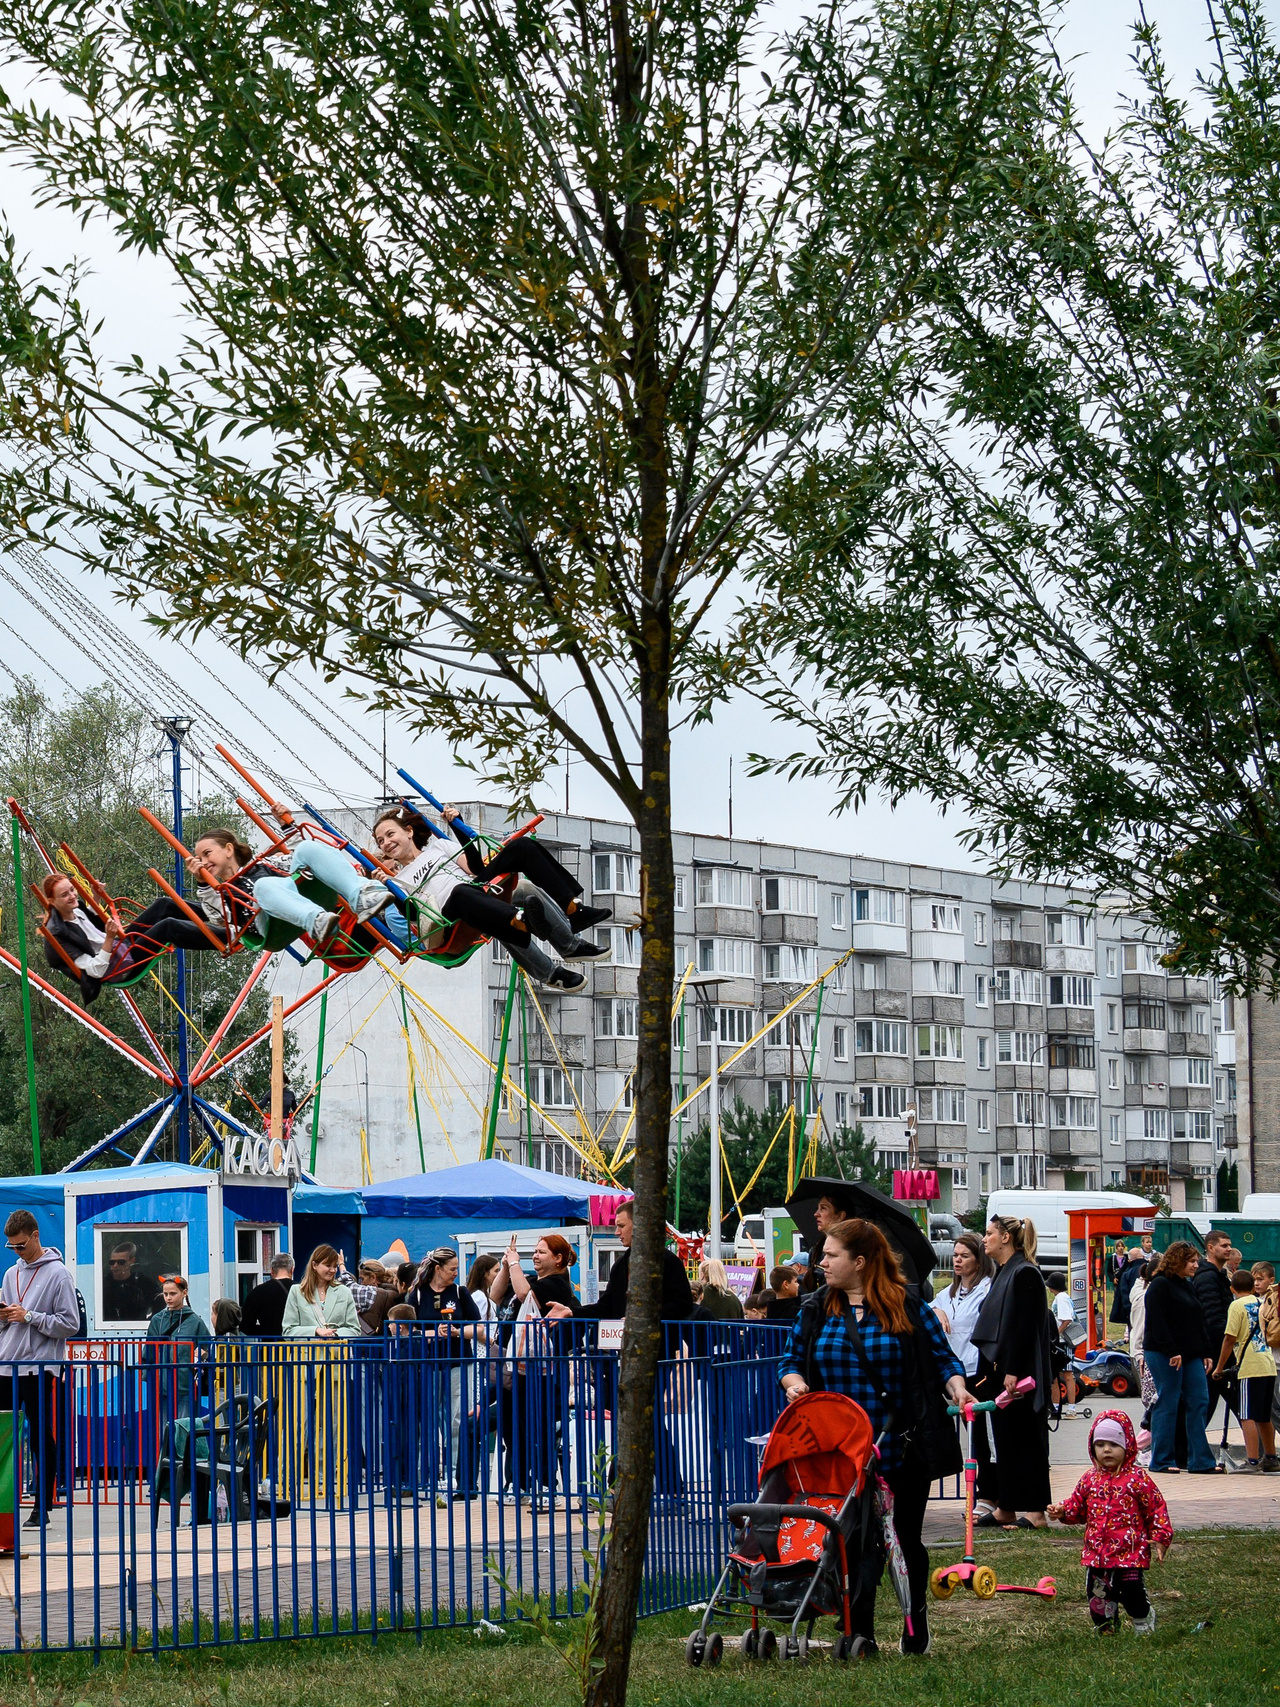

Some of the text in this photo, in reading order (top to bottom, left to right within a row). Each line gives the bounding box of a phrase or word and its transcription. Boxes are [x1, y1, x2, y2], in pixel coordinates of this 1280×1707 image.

[413, 860, 433, 884] NIKE
[224, 1134, 301, 1178] КАССА
[893, 1170, 940, 1199] КАССА
